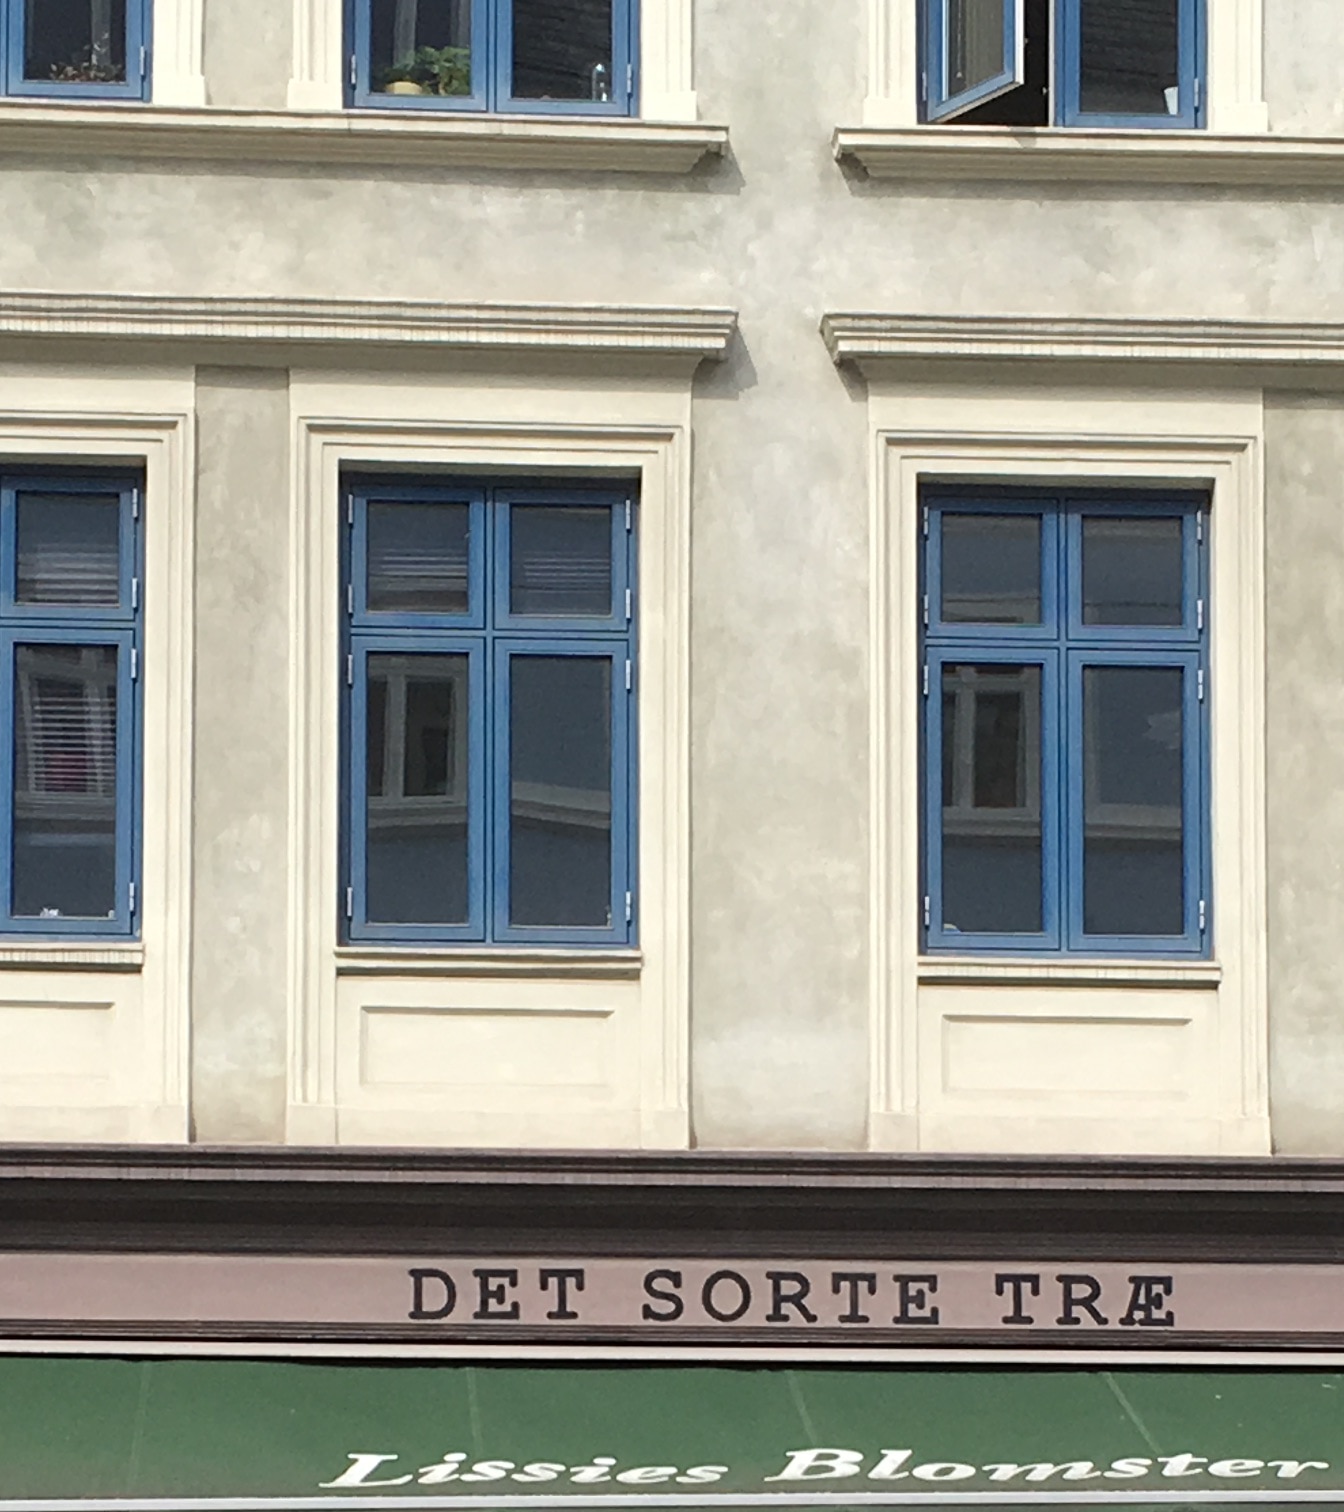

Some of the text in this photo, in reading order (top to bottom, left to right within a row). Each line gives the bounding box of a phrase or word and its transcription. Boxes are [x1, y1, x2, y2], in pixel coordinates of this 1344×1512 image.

[408, 1268, 1175, 1327] DET SORTE TRÆ
[318, 1448, 1329, 1488] Lissies Blomster
